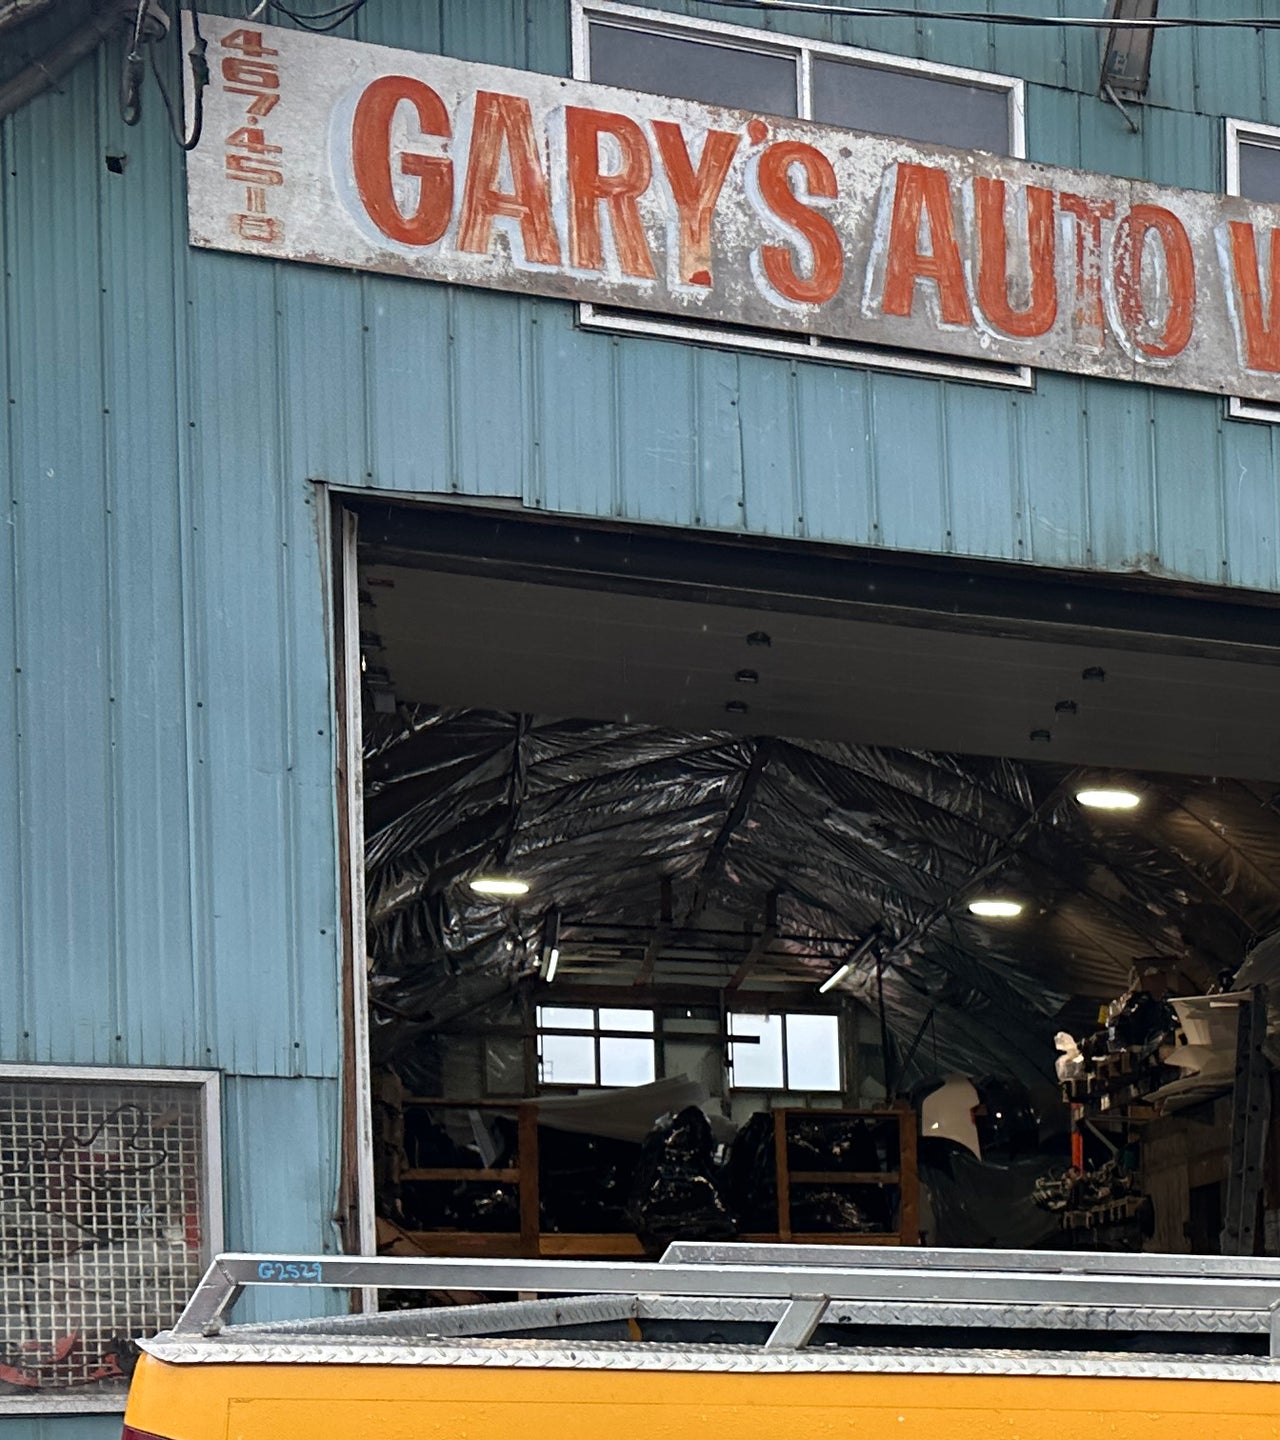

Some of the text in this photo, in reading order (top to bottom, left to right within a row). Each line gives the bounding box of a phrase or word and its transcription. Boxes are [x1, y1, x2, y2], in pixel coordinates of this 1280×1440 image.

[350, 74, 846, 308] GARY'S
[881, 162, 1196, 359] AUTO
[258, 1261, 322, 1283] G2529
